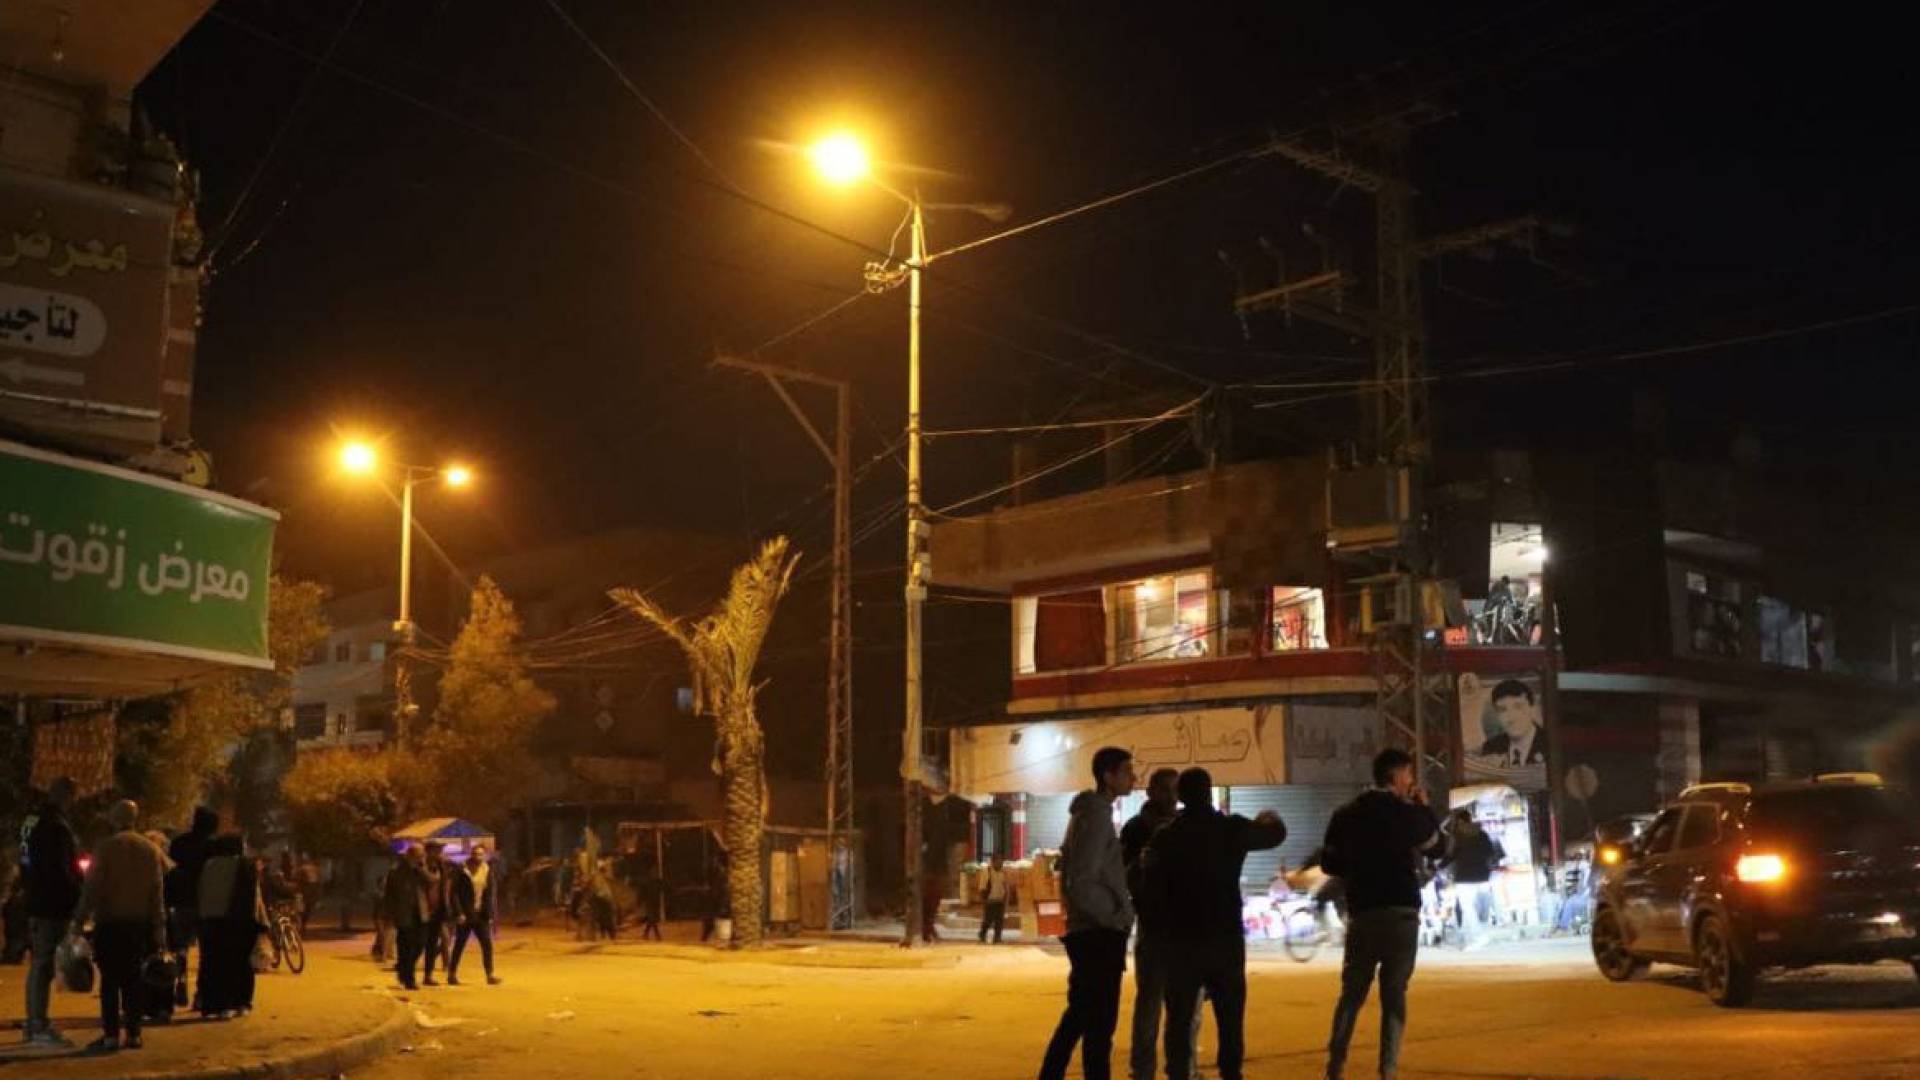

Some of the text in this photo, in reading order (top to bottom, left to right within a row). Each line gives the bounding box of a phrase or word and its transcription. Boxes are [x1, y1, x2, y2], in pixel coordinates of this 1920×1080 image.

[0, 208, 128, 277] معرض
[0, 511, 248, 602] معرض زقوت
